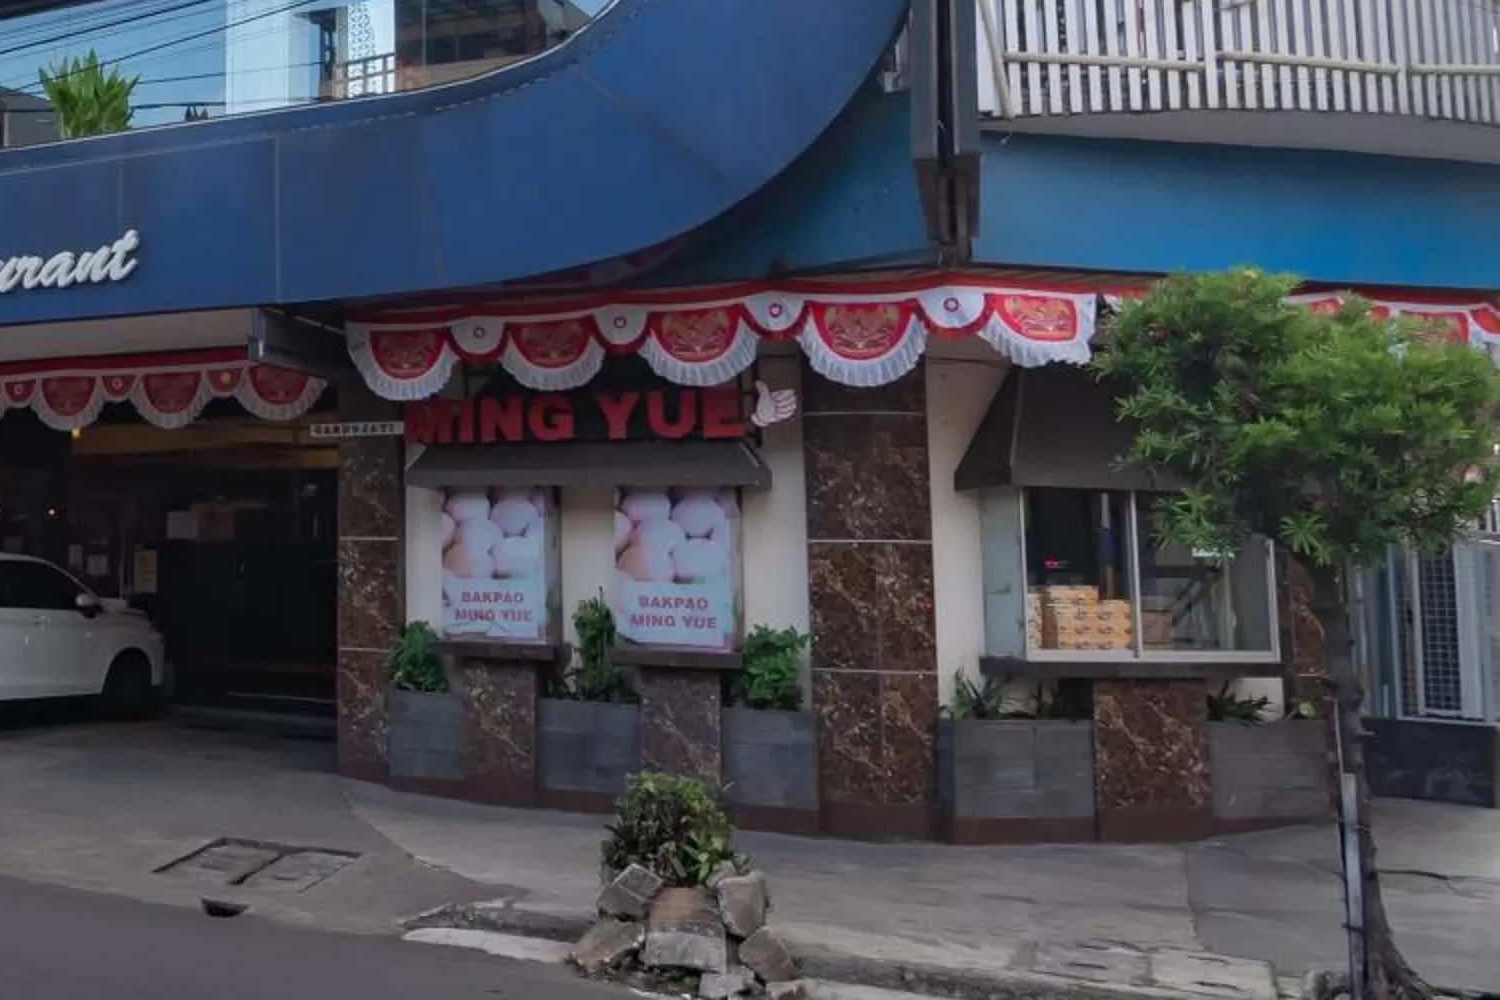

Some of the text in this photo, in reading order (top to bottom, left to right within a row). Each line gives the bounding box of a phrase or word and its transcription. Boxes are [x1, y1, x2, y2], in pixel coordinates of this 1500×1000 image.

[405, 388, 746, 444] MING YUE
[461, 591, 524, 604] BAKPAO
[638, 595, 709, 610] BAKPAO
[455, 609, 533, 622] MING YUE
[631, 614, 717, 629] MING YUE
